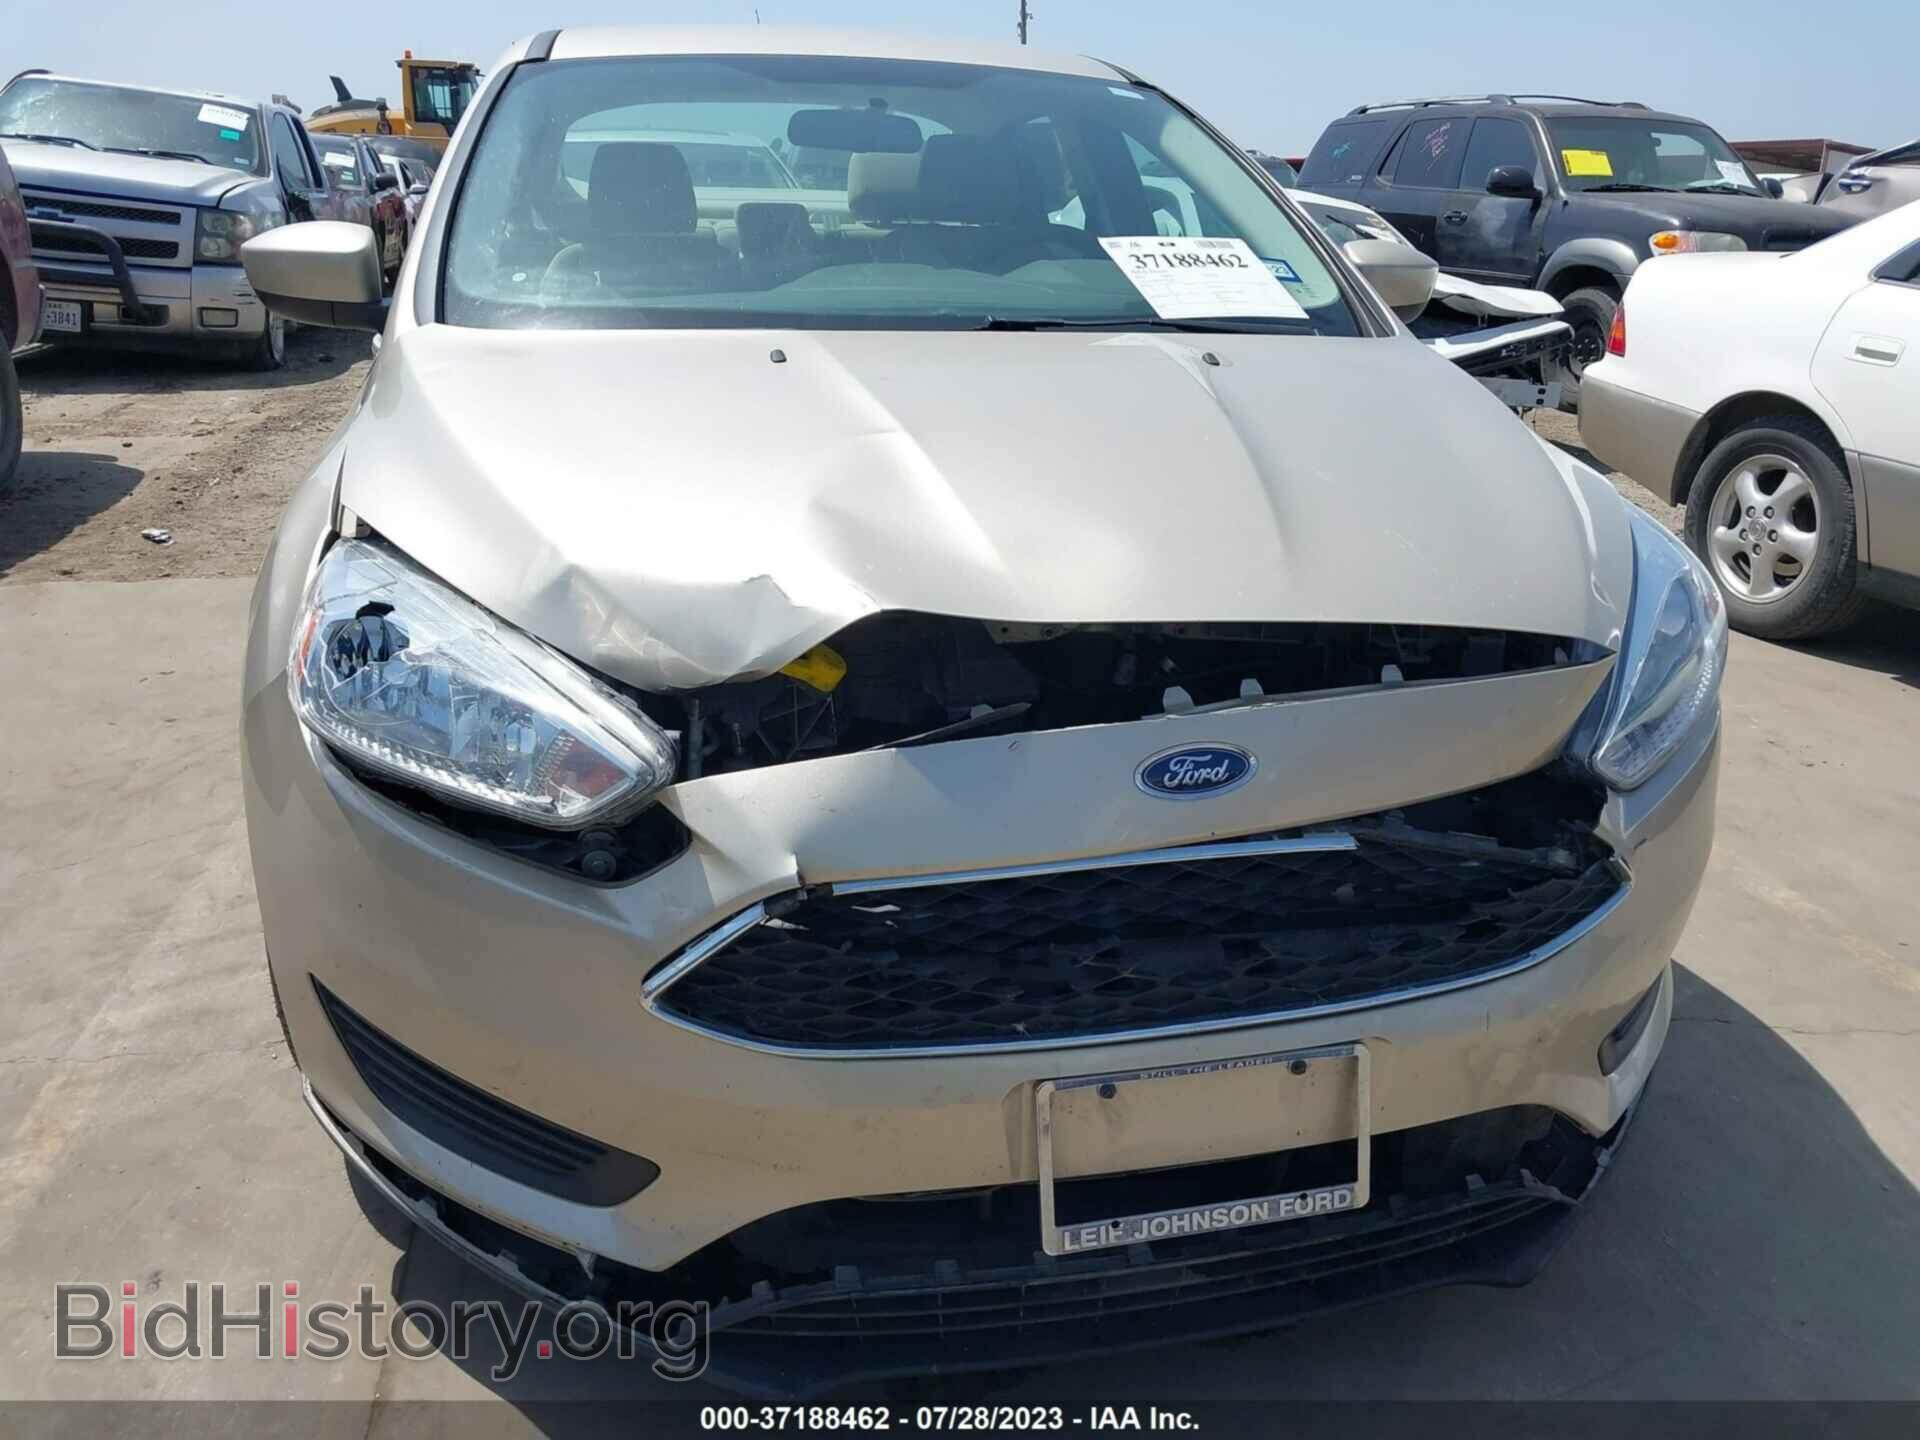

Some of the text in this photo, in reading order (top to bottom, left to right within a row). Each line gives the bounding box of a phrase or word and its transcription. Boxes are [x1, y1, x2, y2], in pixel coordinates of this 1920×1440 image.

[1128, 253, 1249, 269] 37188462
[1163, 754, 1230, 788] Ford
[1063, 1187, 1352, 1252] LEIF JOHNSON FORD
